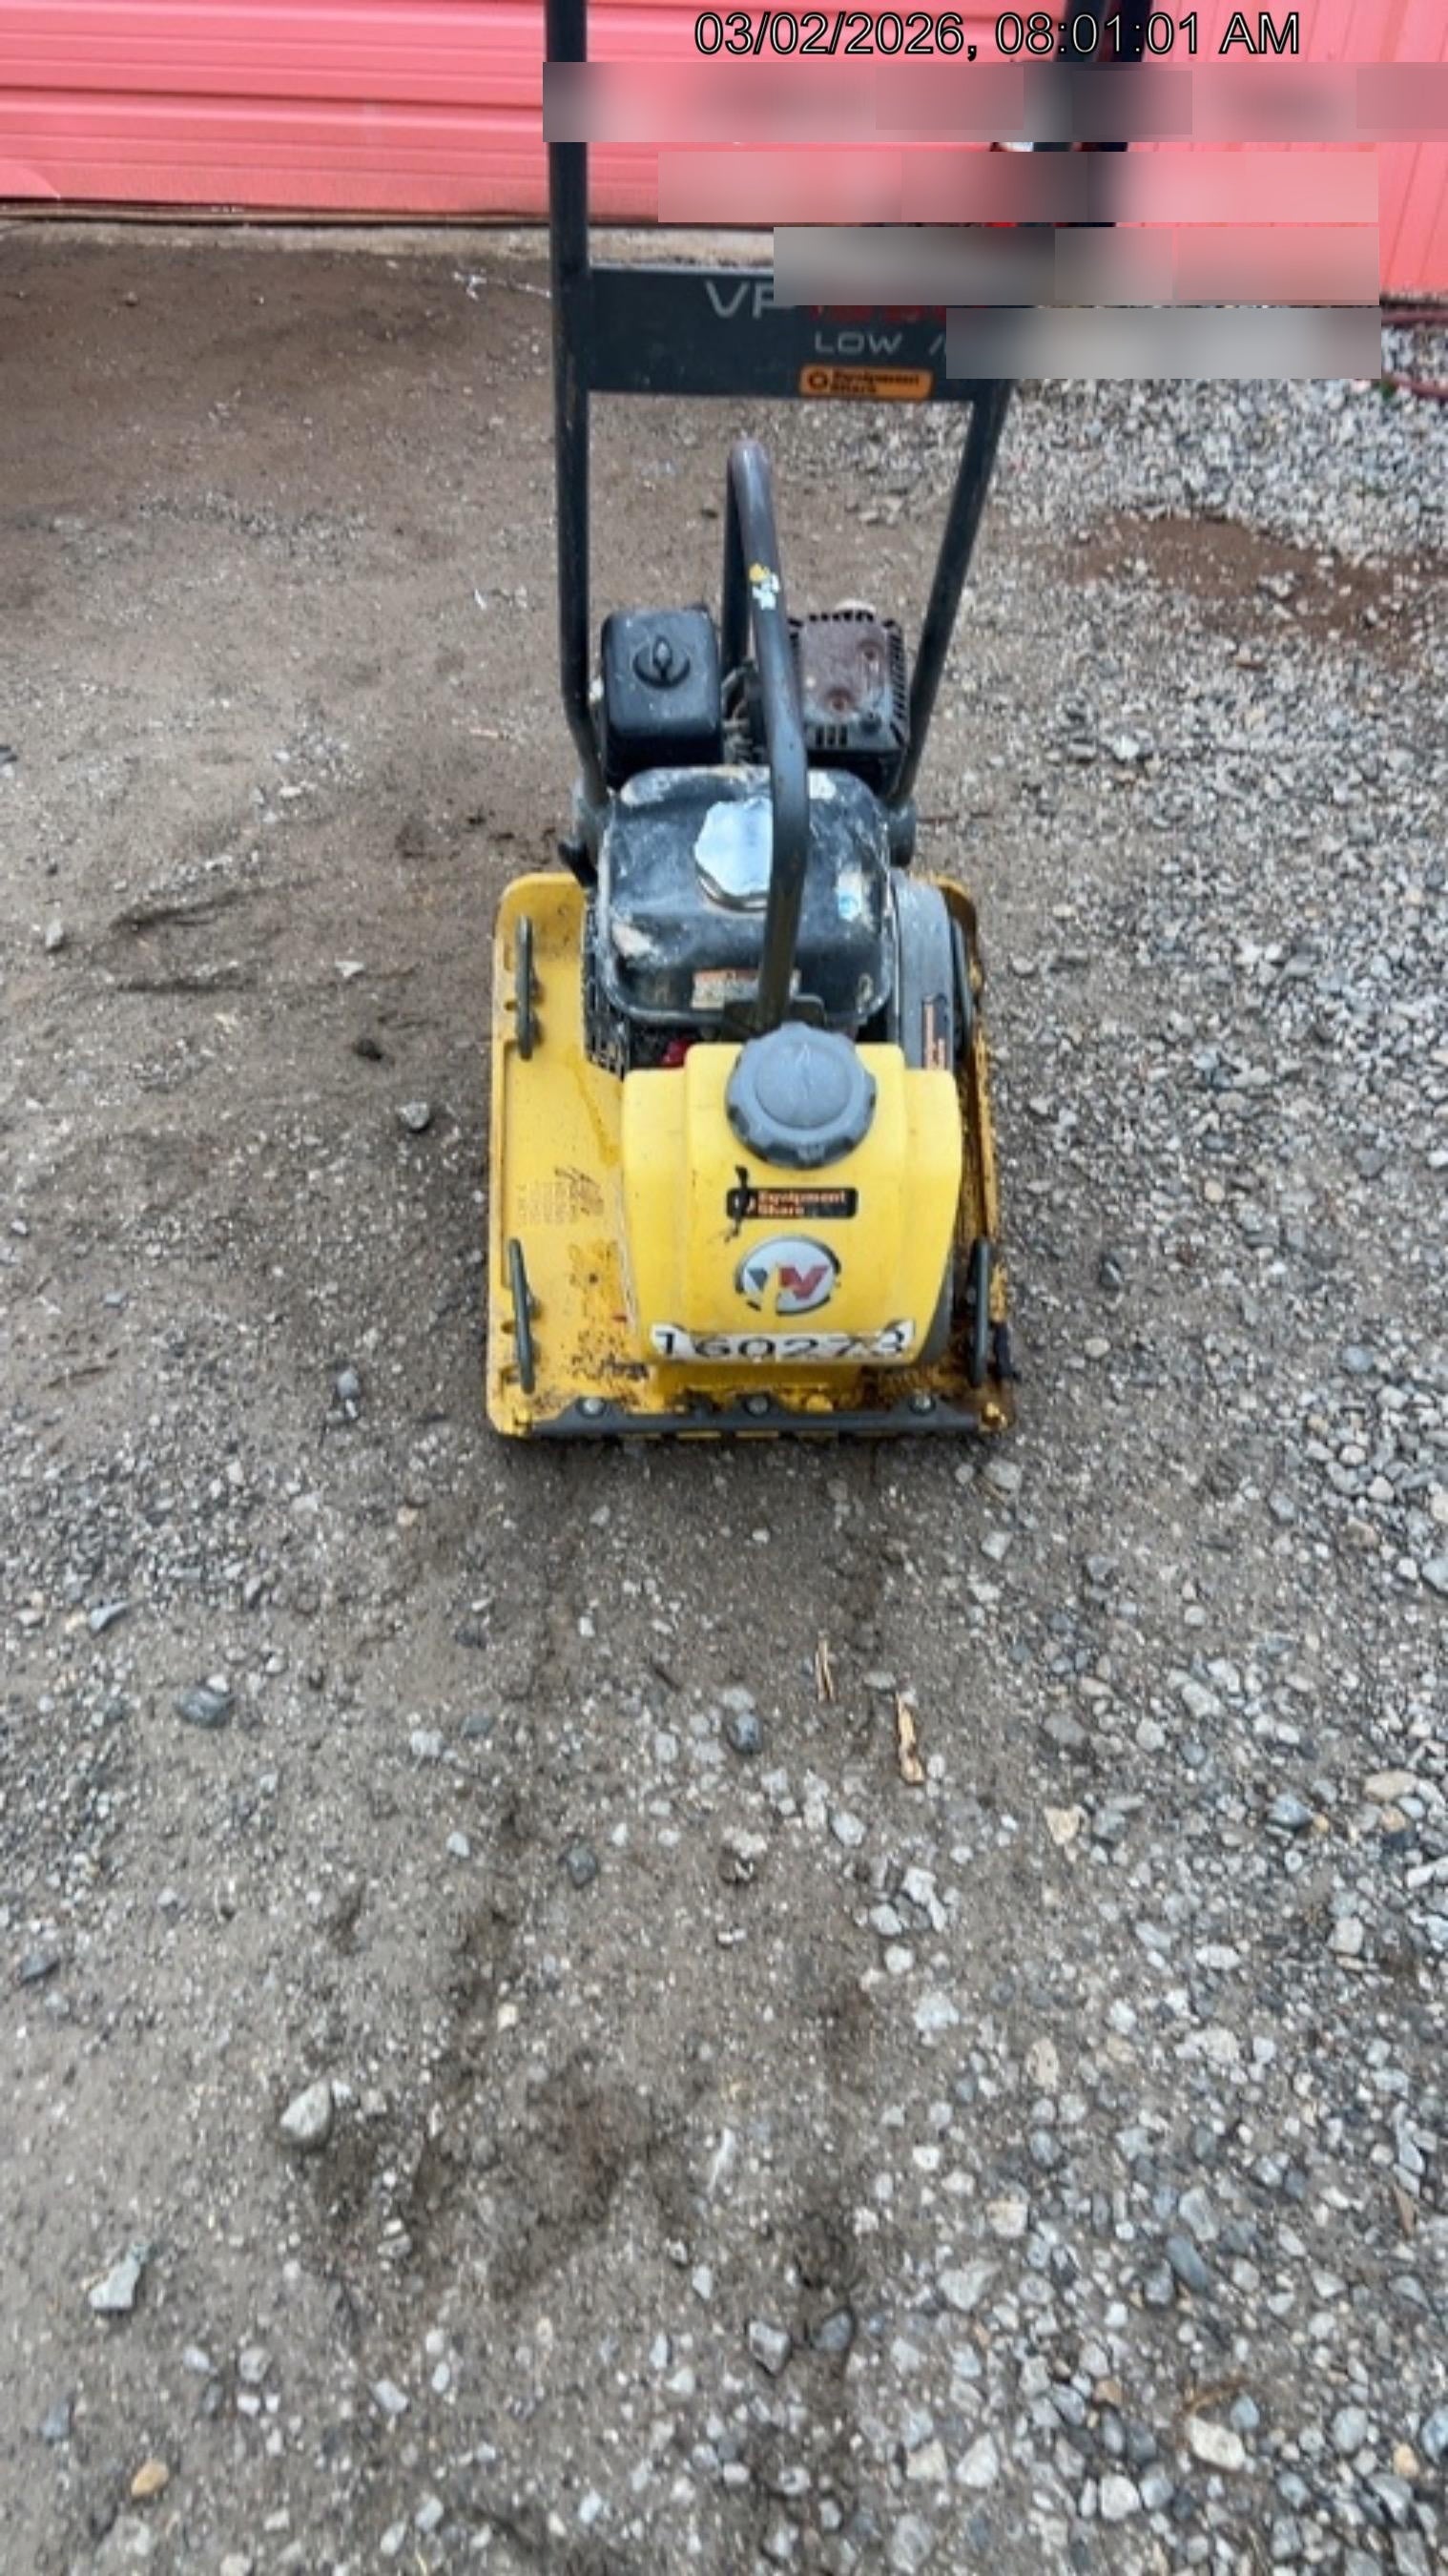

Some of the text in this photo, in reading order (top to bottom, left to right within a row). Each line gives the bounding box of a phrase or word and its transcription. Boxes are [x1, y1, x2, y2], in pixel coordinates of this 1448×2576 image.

[814, 332, 902, 355] LOW
[757, 1190, 845, 1205] Equipment
[757, 1203, 805, 1215] Share
